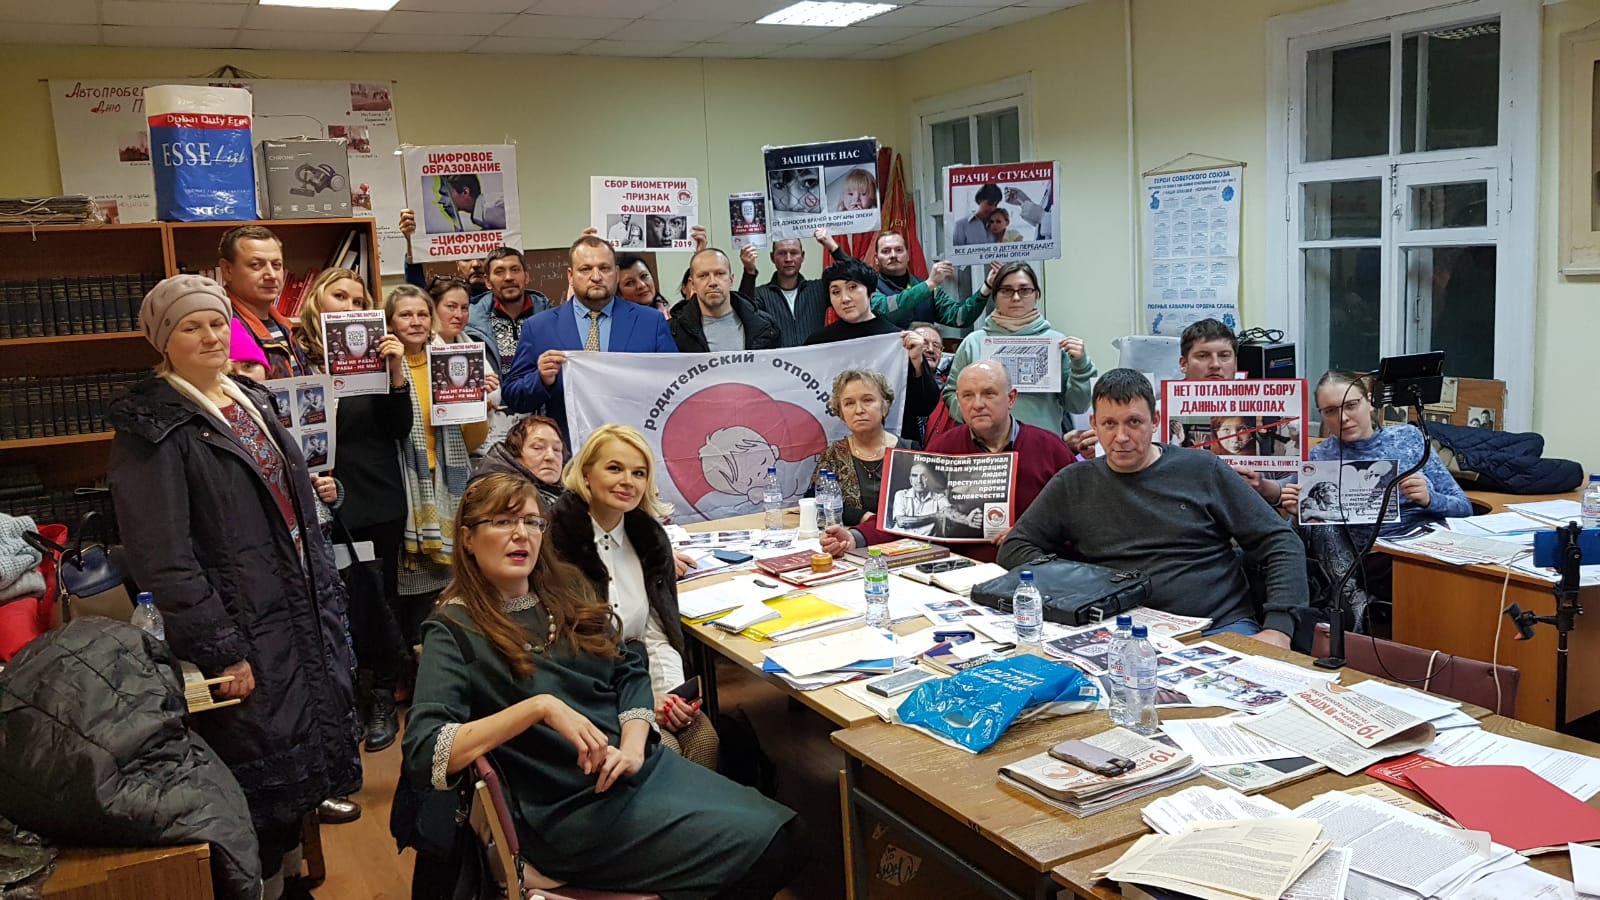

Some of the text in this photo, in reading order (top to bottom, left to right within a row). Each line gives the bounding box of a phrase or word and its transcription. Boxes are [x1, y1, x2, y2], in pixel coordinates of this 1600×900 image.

[167, 114, 198, 124] Dubai
[201, 116, 224, 126] Duty
[162, 142, 212, 166] ESSE
[428, 152, 493, 164] ЦИФРОВОЕ
[781, 150, 860, 165] ЗАЩИТИТЕ НАС
[422, 162, 502, 174] ОБРАЗОВАНИЕ
[952, 173, 988, 184] ВРАЧИ
[998, 168, 1052, 180] СТУКАЧИ
[604, 180, 687, 190] СБОР БИОМЕТРИИ
[622, 192, 670, 201] -ПРИЗНАК
[621, 204, 671, 213] ФАШИЗМА
[432, 232, 502, 246] =ЦИФРОВОЕ
[430, 243, 501, 256] СЛАБОУМИЕ
[998, 245, 1018, 253] ДЕТЯХ
[1020, 242, 1054, 250] ПЕРЕДАДУТ
[644, 352, 754, 431] родительский
[1174, 383, 1296, 396] НЕТ ТОТАЛЬНОМУ СБОРУ
[1180, 400, 1285, 414] ДАННЫХ В ШКОЛАХ
[913, 454, 1008, 466] Нюрнбергский трибунал
[964, 464, 1008, 474] нумерацию
[982, 470, 1008, 478] людей
[948, 478, 1007, 487] преступлением
[1356, 724, 1384, 740] 19
[1150, 748, 1176, 763] 19
